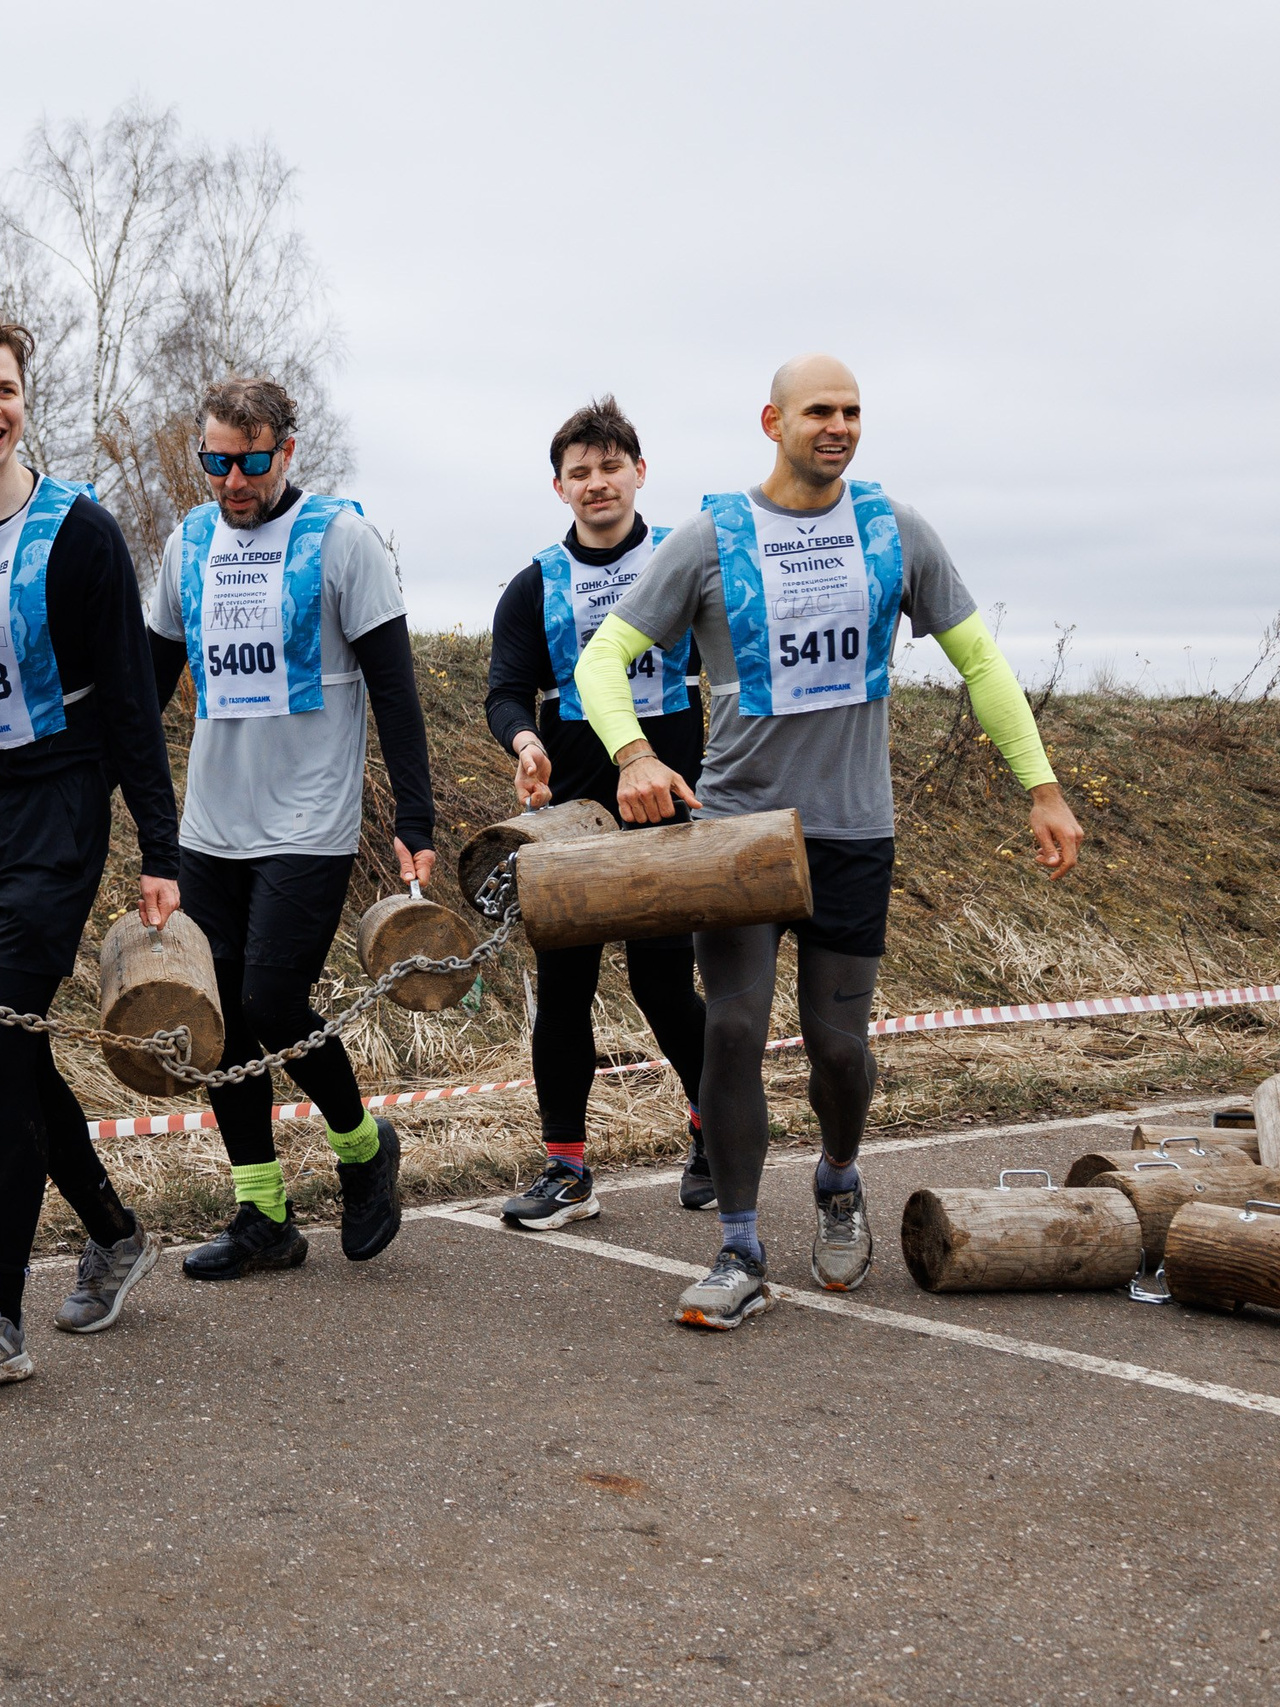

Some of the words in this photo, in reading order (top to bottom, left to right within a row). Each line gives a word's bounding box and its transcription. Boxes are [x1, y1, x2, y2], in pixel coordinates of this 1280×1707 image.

[764, 542, 805, 553] ГОНКА
[807, 535, 854, 548] ГЕРОЕВ
[210, 553, 239, 564] ГОНКА
[242, 551, 282, 561] ГЕРОЕВ
[779, 556, 845, 575] Sminex
[215, 570, 268, 586] Sminex
[576, 580, 609, 591] ГОНКА
[612, 573, 640, 583] ГЕРО
[782, 575, 848, 587] ПЕРФЕКЦИОНИСТЫ
[801, 583, 848, 593] DEVELOPMENT
[779, 626, 859, 667] 5410
[208, 641, 276, 677] 5400
[805, 682, 851, 695] ГАЗПРОМБАНК
[228, 695, 271, 704] ГАЗПРОМБАНК
